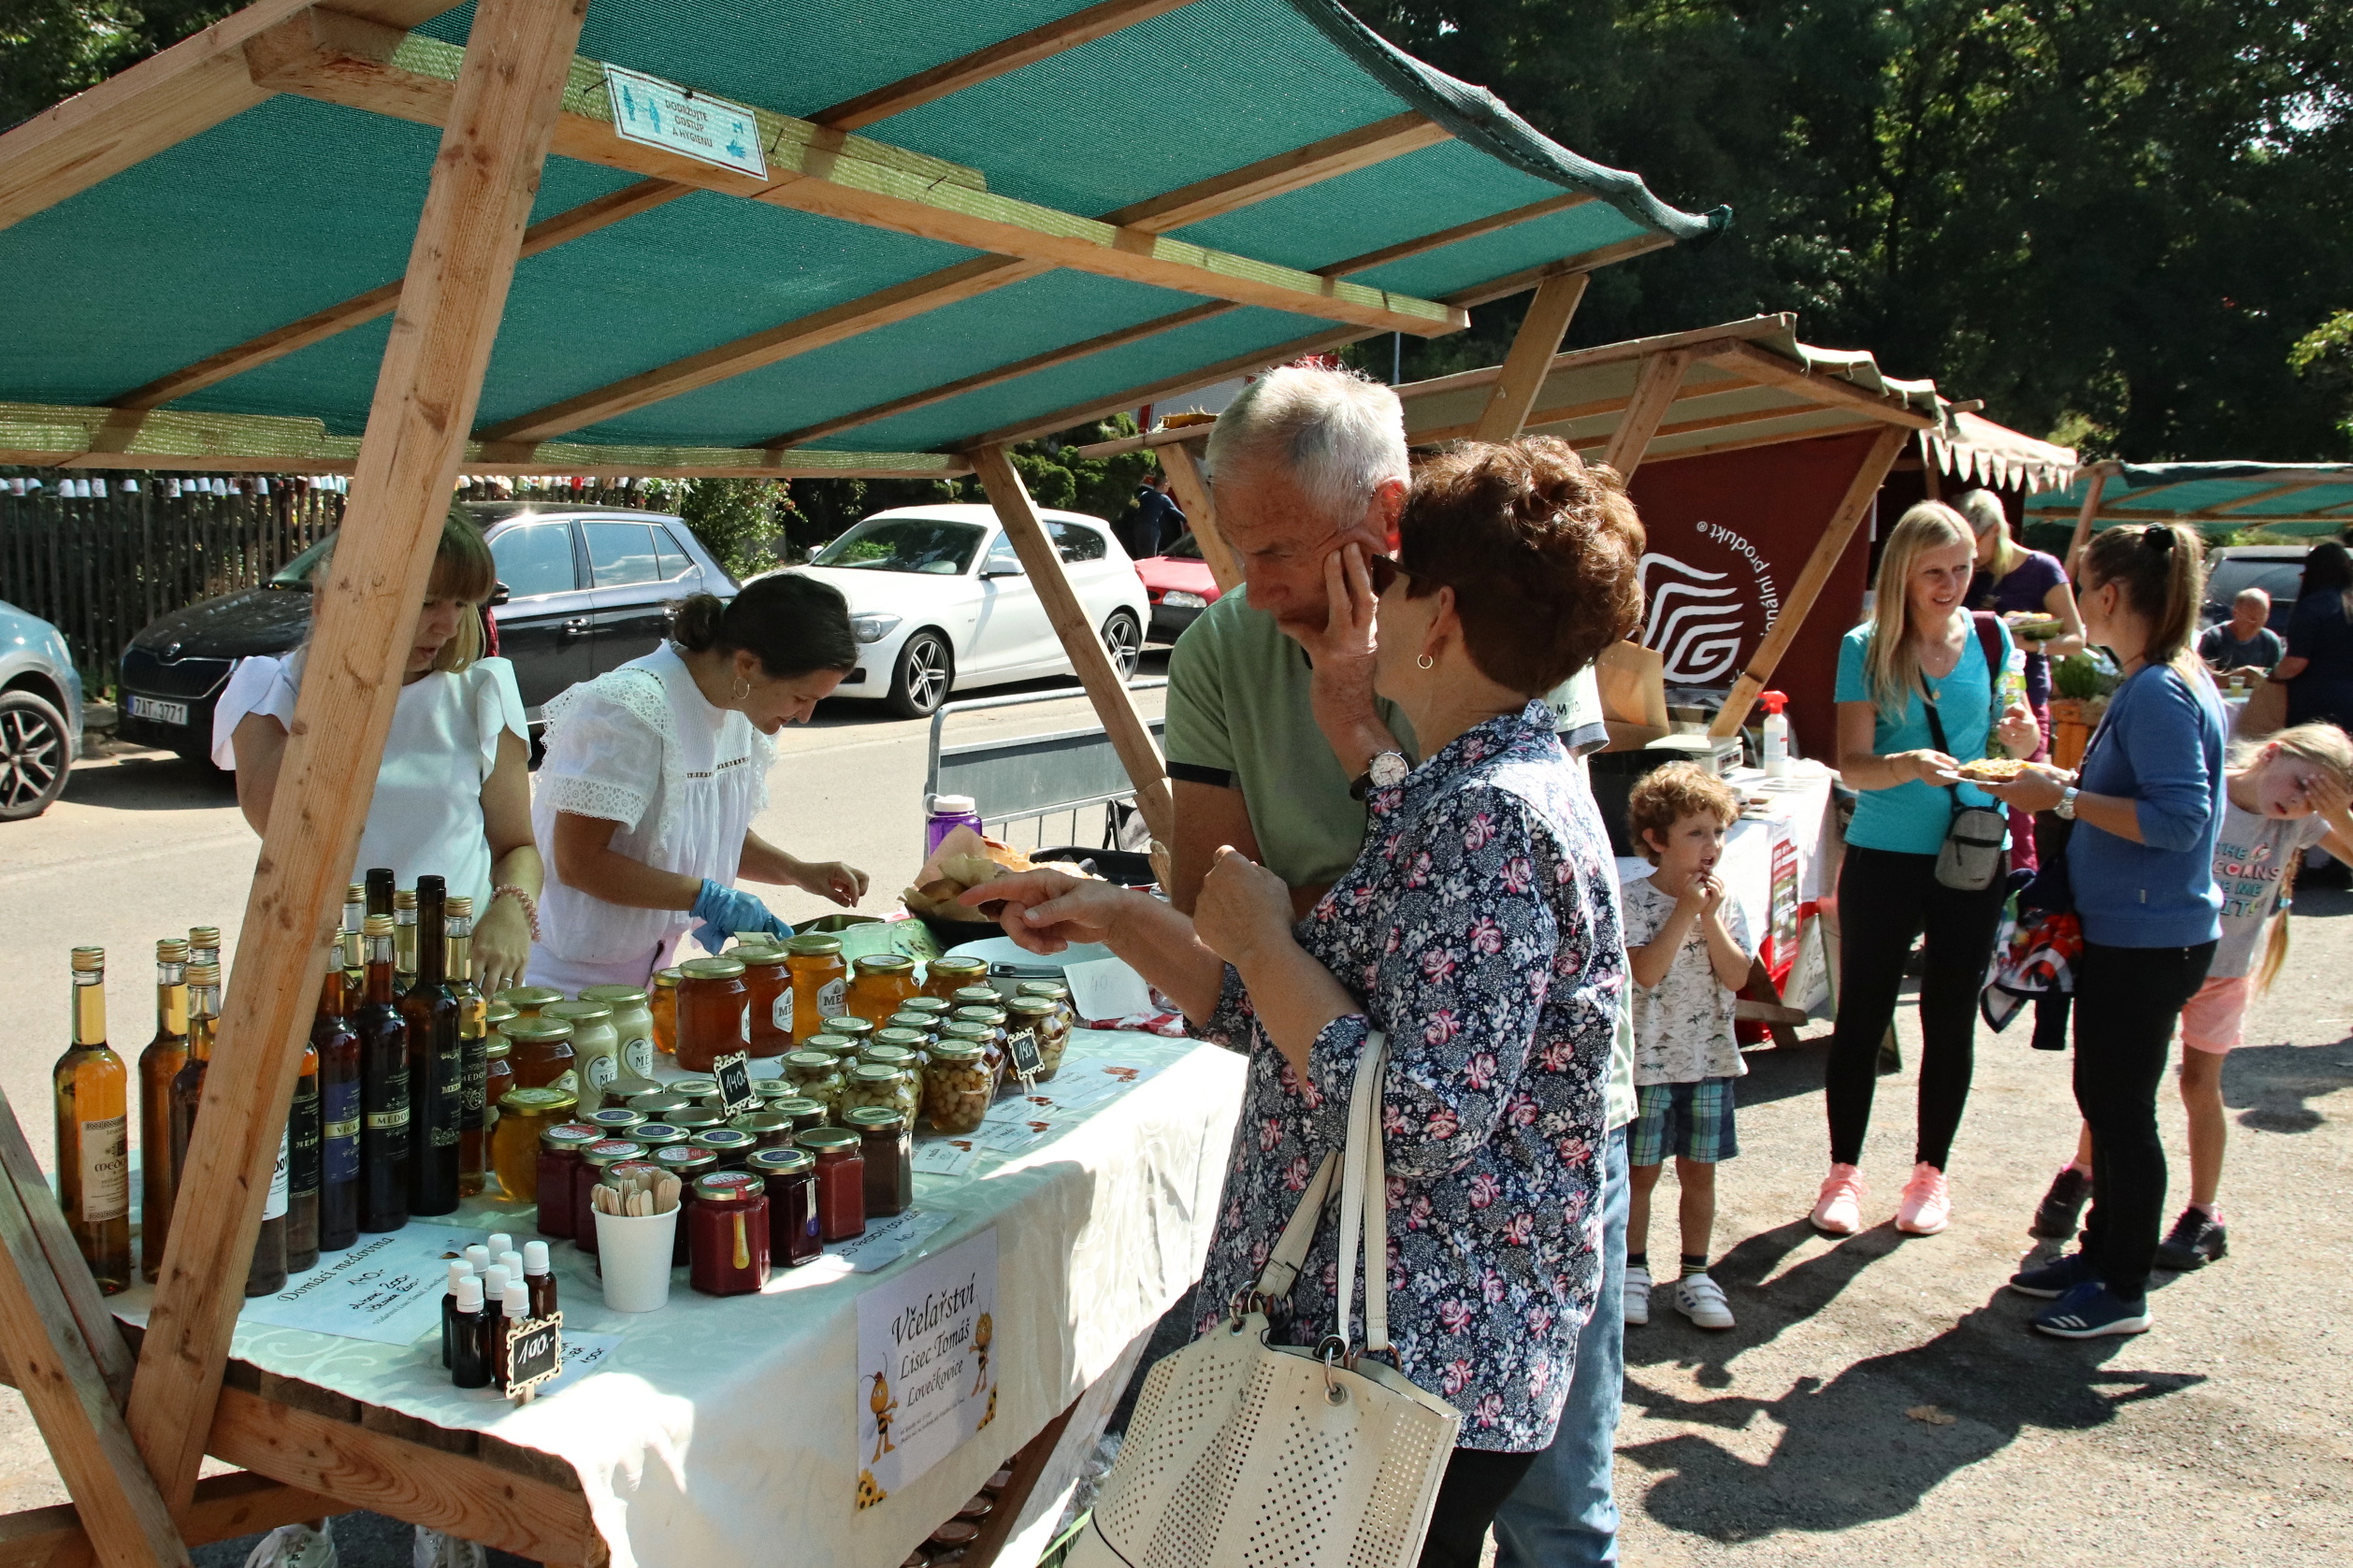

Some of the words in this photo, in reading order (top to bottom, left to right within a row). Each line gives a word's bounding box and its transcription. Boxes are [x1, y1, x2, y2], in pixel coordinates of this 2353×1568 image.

[675, 117, 704, 132] ODSTUP
[672, 127, 679, 137] A
[680, 129, 714, 148] HYGIENU
[1709, 523, 1770, 574] produkt
[135, 698, 154, 716] 7AT
[158, 703, 183, 723] 3771
[2216, 842, 2248, 860] THE
[2213, 859, 2280, 882] CORNS
[891, 1272, 976, 1348] Včelařství
[899, 1346, 933, 1381] Lisec
[933, 1315, 972, 1365] Tomáš
[906, 1359, 964, 1407] Lovečkovice
